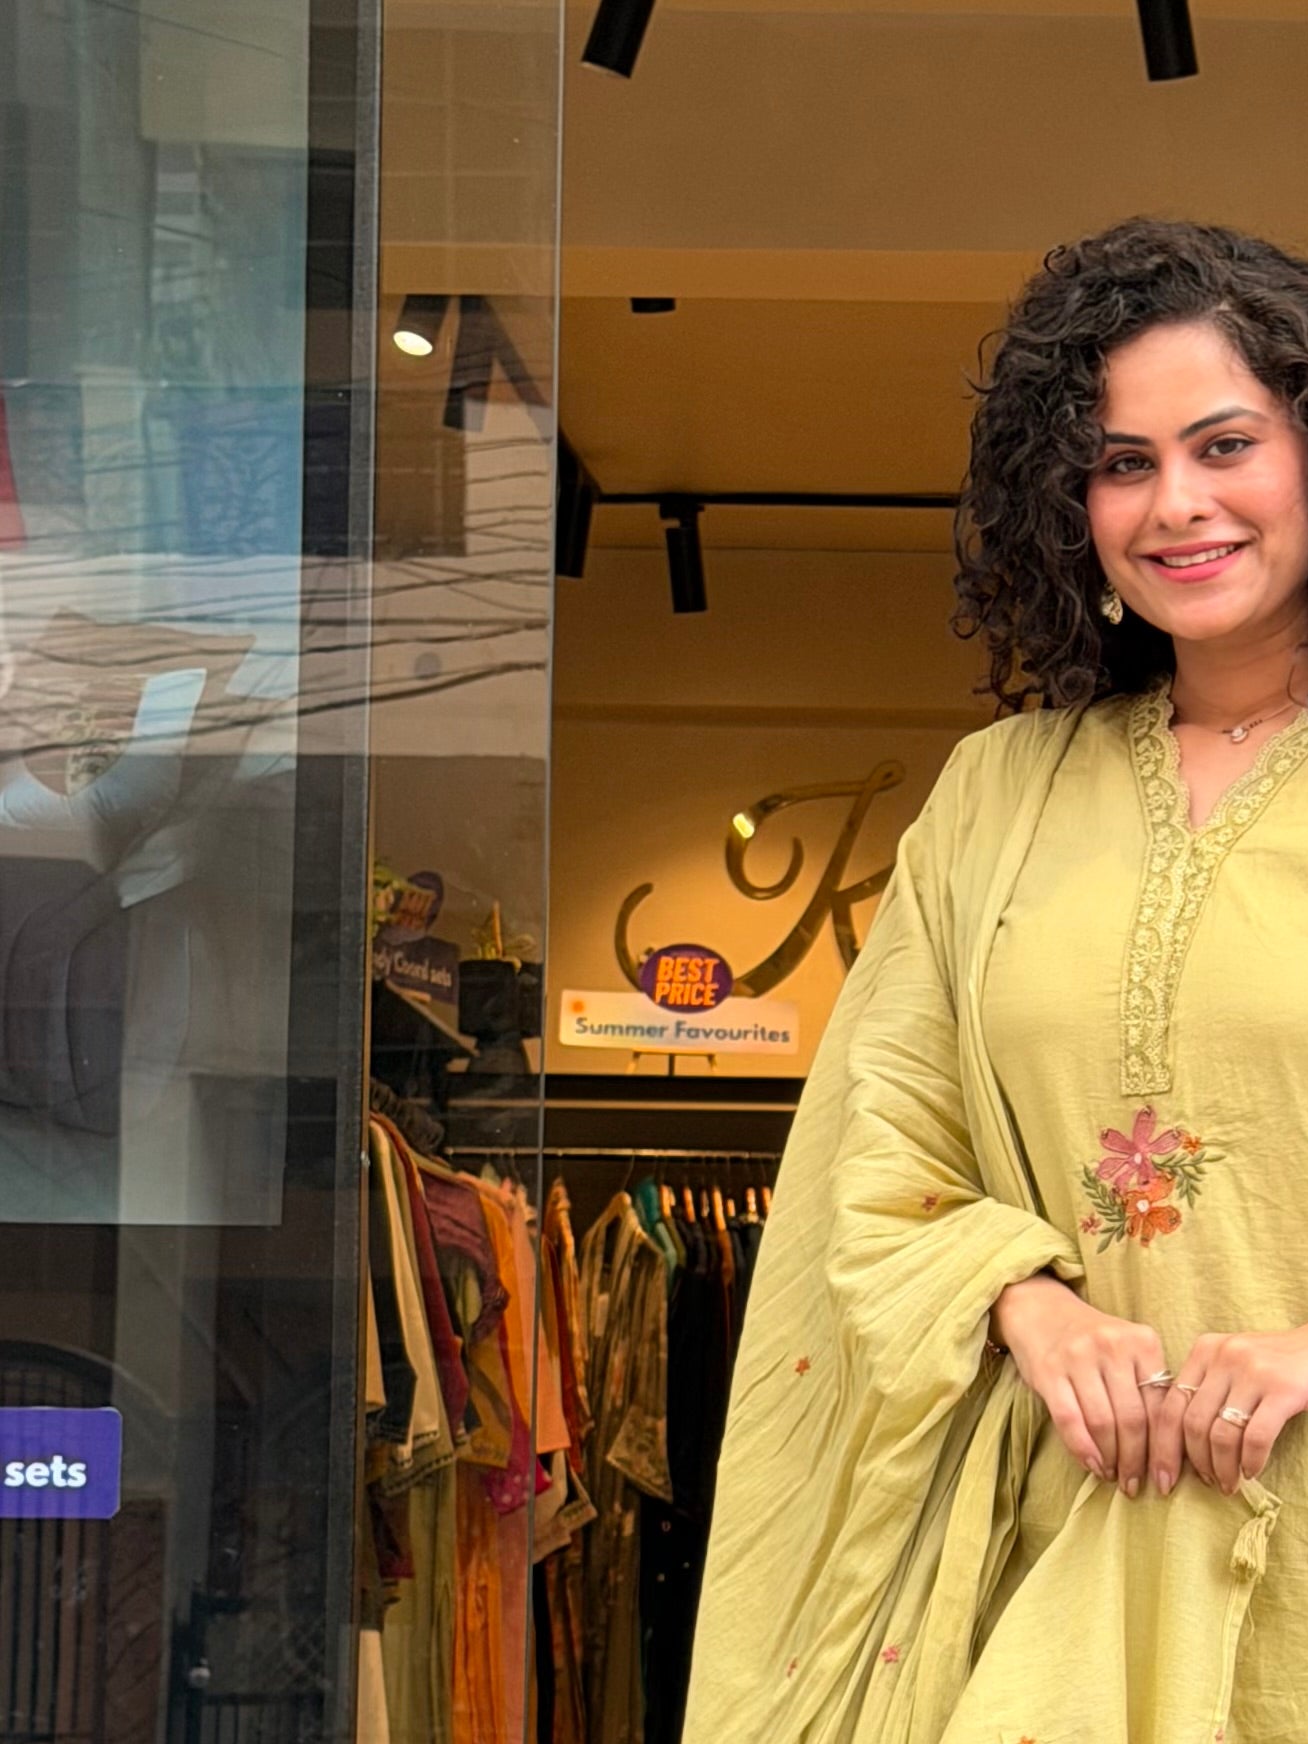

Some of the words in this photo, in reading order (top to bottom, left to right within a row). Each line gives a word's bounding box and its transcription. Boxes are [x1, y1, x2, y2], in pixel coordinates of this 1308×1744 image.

[657, 955, 720, 982] BEST
[654, 982, 720, 1007] PRICE
[575, 1016, 668, 1040] Summer
[674, 1020, 791, 1044] Favourites
[4, 1454, 87, 1488] sets
